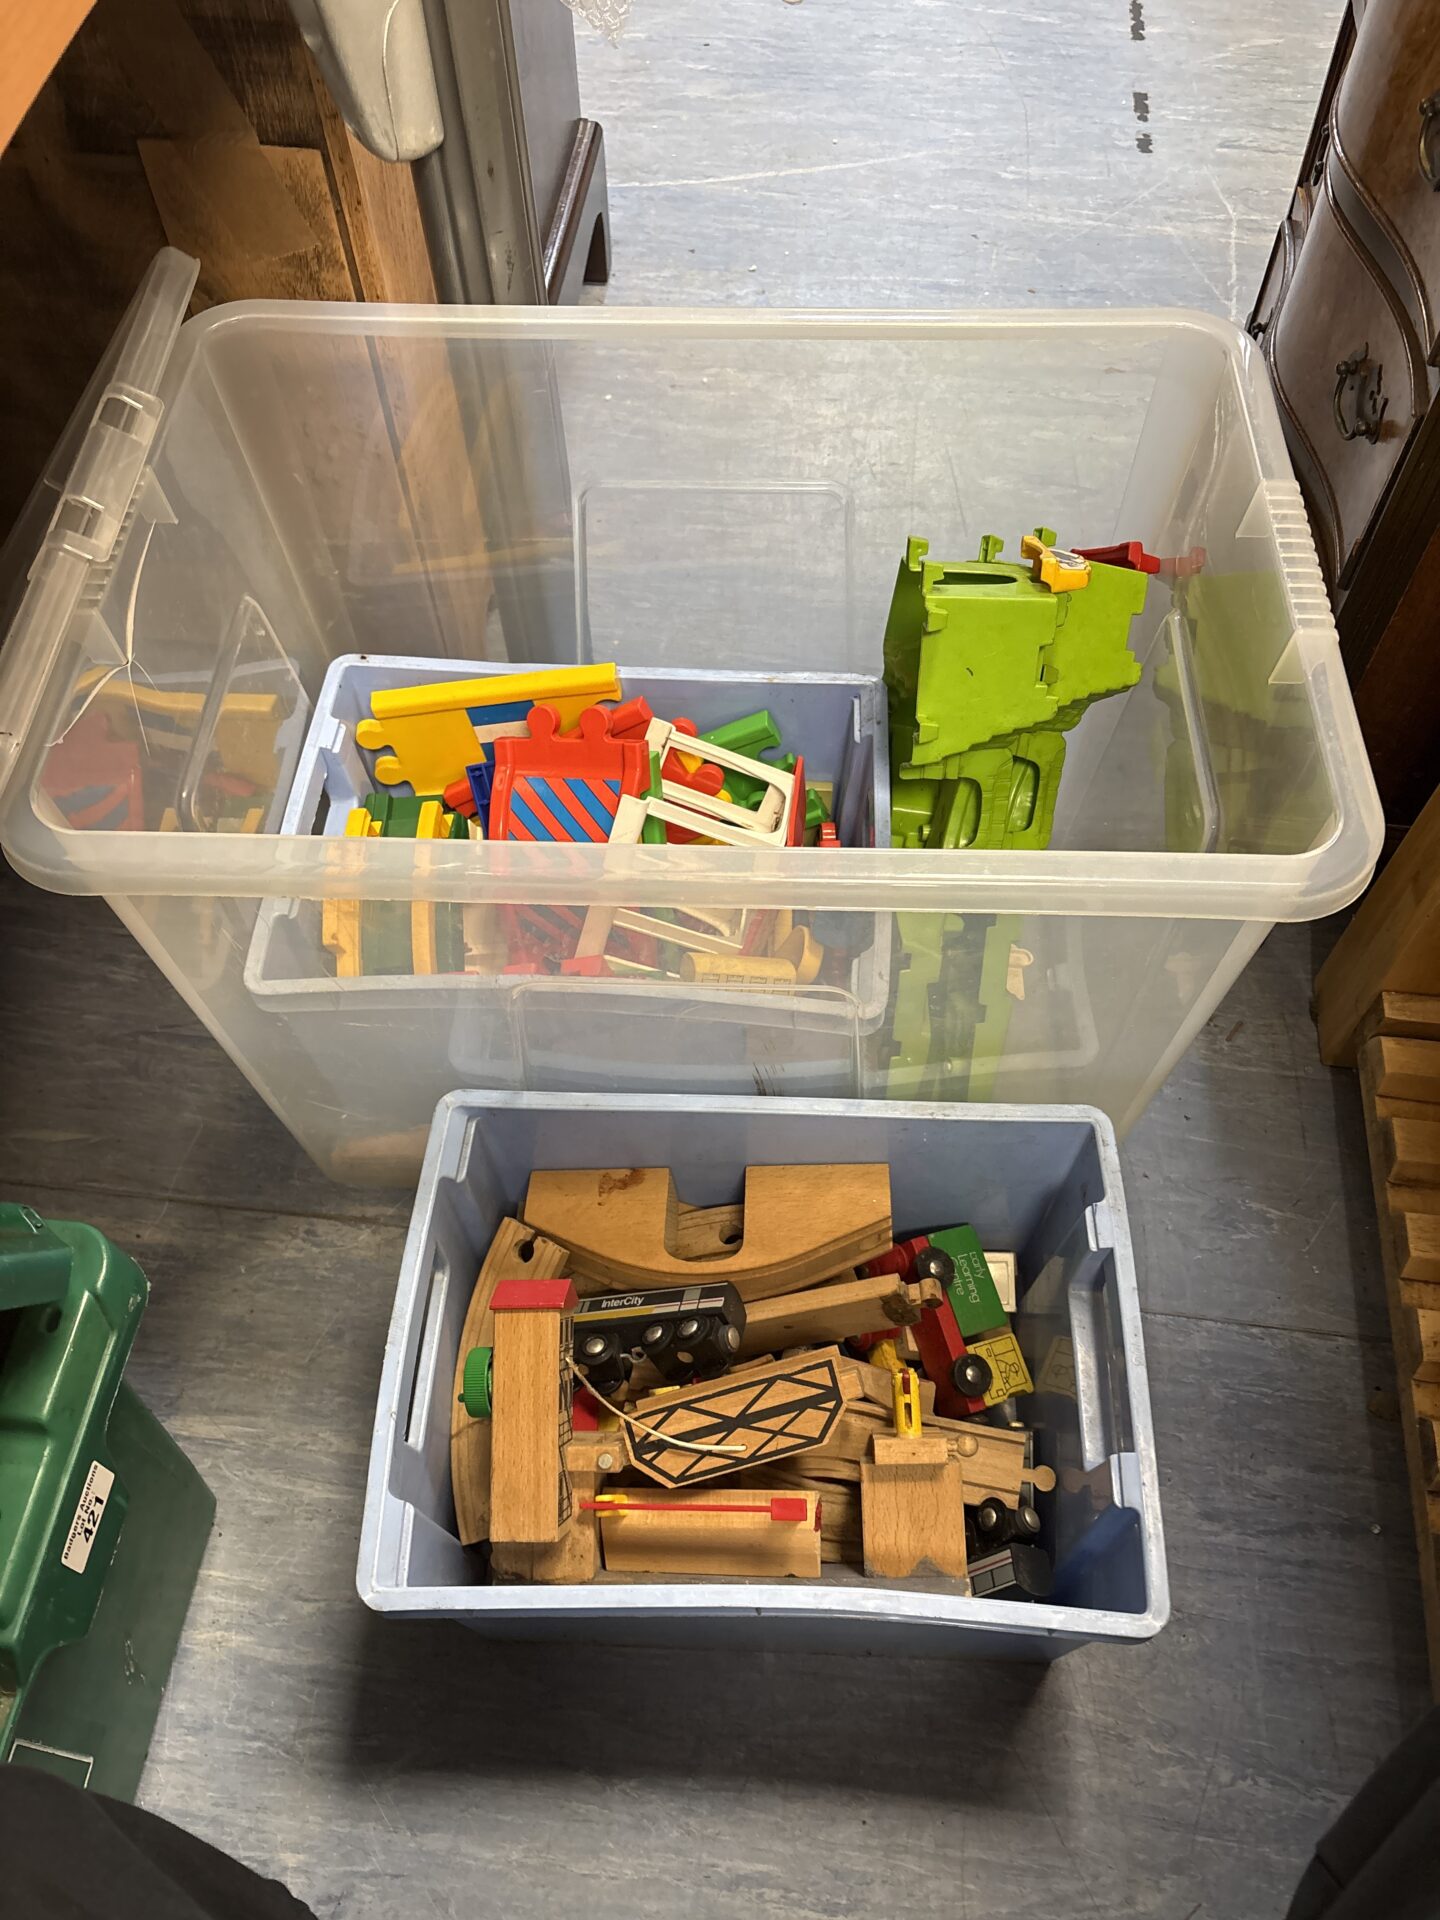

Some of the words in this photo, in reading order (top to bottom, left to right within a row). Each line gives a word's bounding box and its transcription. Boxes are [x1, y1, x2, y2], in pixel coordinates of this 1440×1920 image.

[601, 1296, 644, 1308] InterCity
[957, 1253, 980, 1303] Learning
[64, 1515, 81, 1559] Badgers
[80, 1465, 98, 1511] Auctions
[77, 1518, 86, 1536] Lot
[83, 1495, 104, 1543] 421
